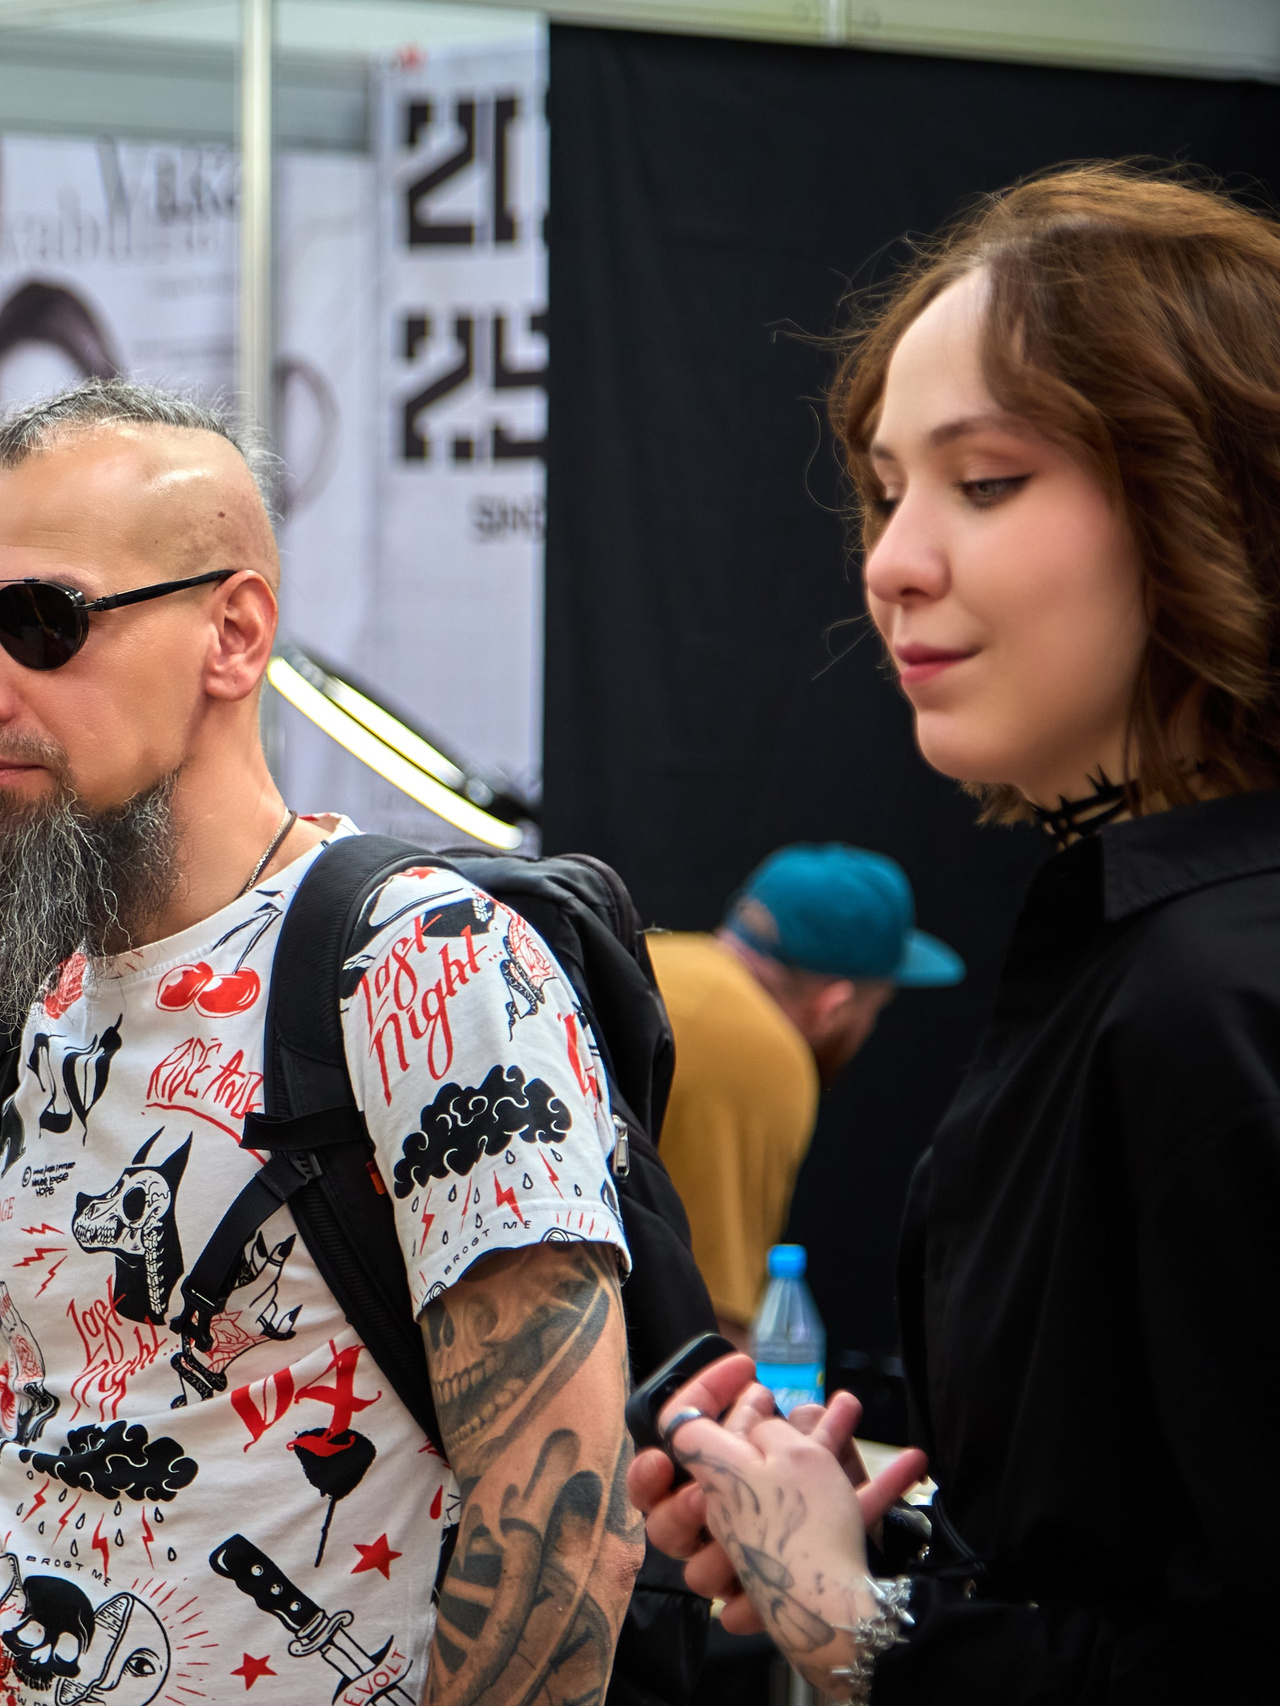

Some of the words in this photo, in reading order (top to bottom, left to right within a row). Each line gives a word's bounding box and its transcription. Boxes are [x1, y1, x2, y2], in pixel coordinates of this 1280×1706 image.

[35, 1186, 55, 1198] HOPE
[502, 1219, 532, 1230] ME
[91, 1568, 112, 1588] ME
